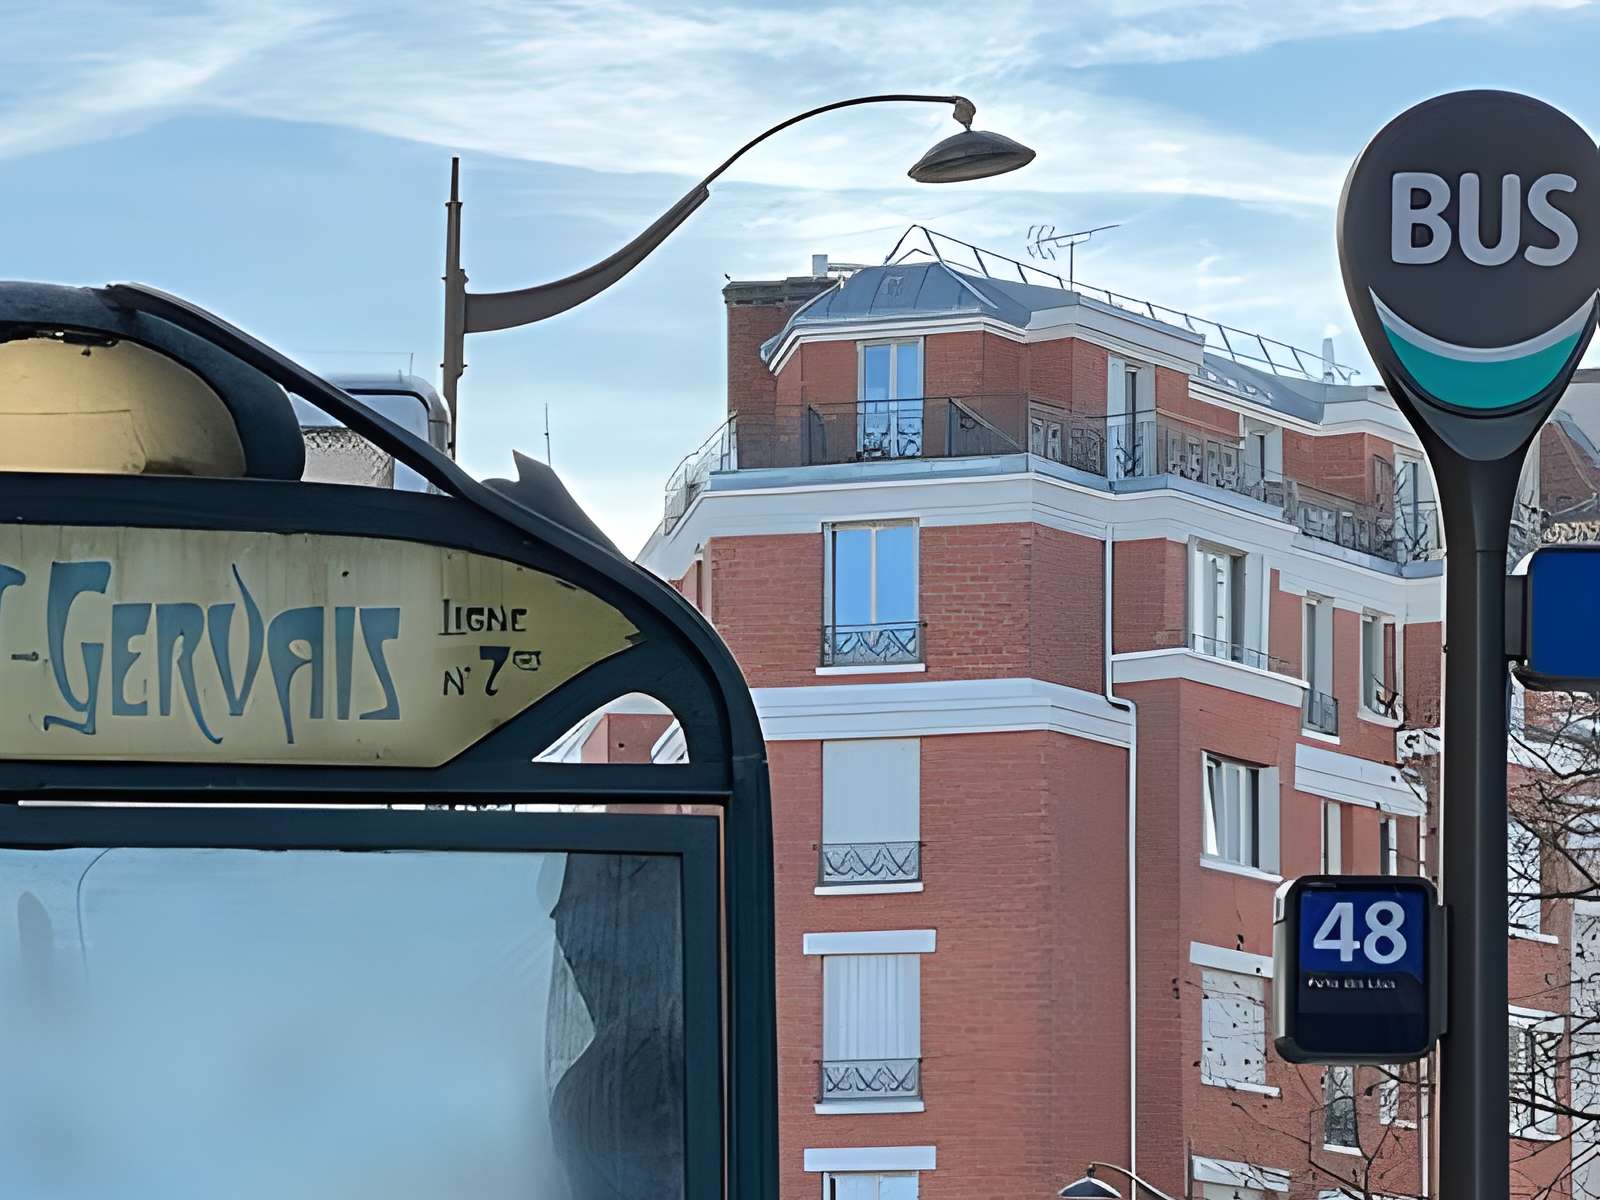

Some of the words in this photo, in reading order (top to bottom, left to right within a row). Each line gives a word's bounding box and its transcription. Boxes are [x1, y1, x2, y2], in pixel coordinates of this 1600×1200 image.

[1391, 172, 1579, 267] BUS
[438, 599, 528, 635] LIGNE
[1313, 900, 1407, 965] 48
